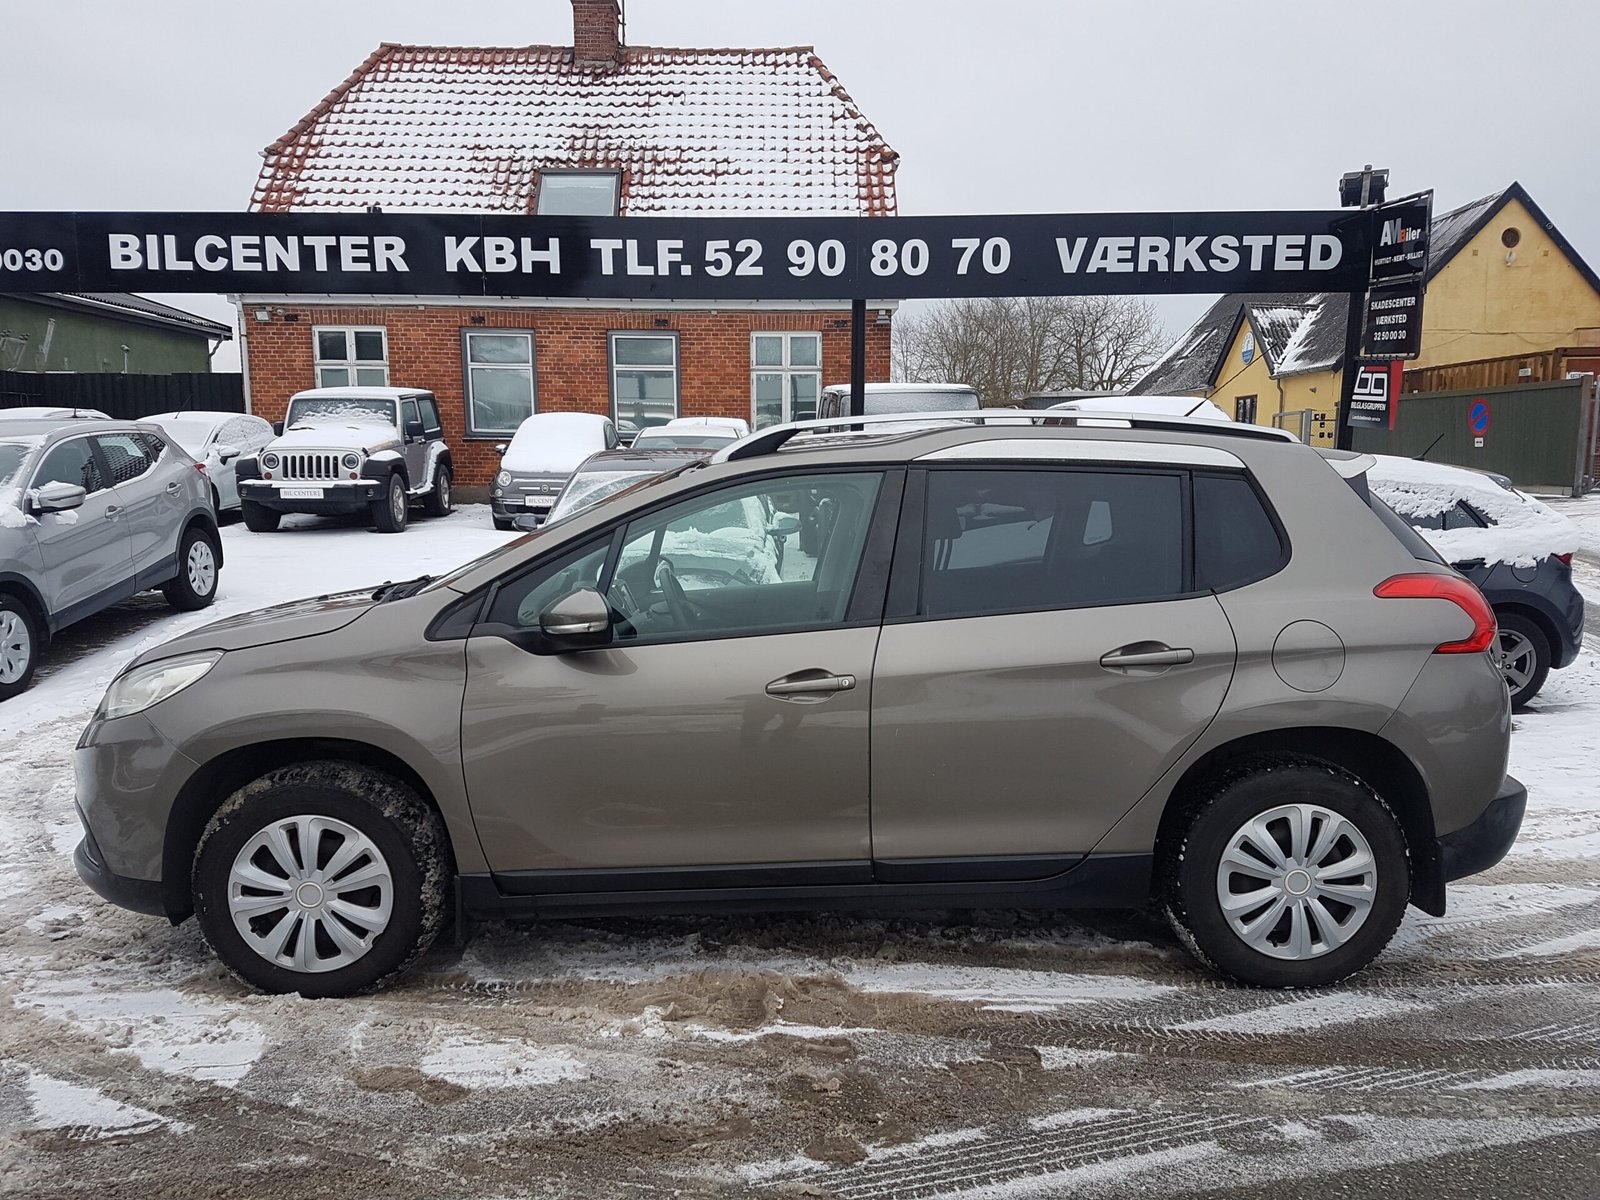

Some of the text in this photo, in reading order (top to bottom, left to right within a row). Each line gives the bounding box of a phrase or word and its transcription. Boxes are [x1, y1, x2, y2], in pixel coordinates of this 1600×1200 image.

[0, 248, 64, 272] 030
[108, 233, 1343, 277] BILCENTER KBH TLF. 52 90 80 70 VÆRKSTED
[1370, 296, 1416, 311] SKADESCENTER
